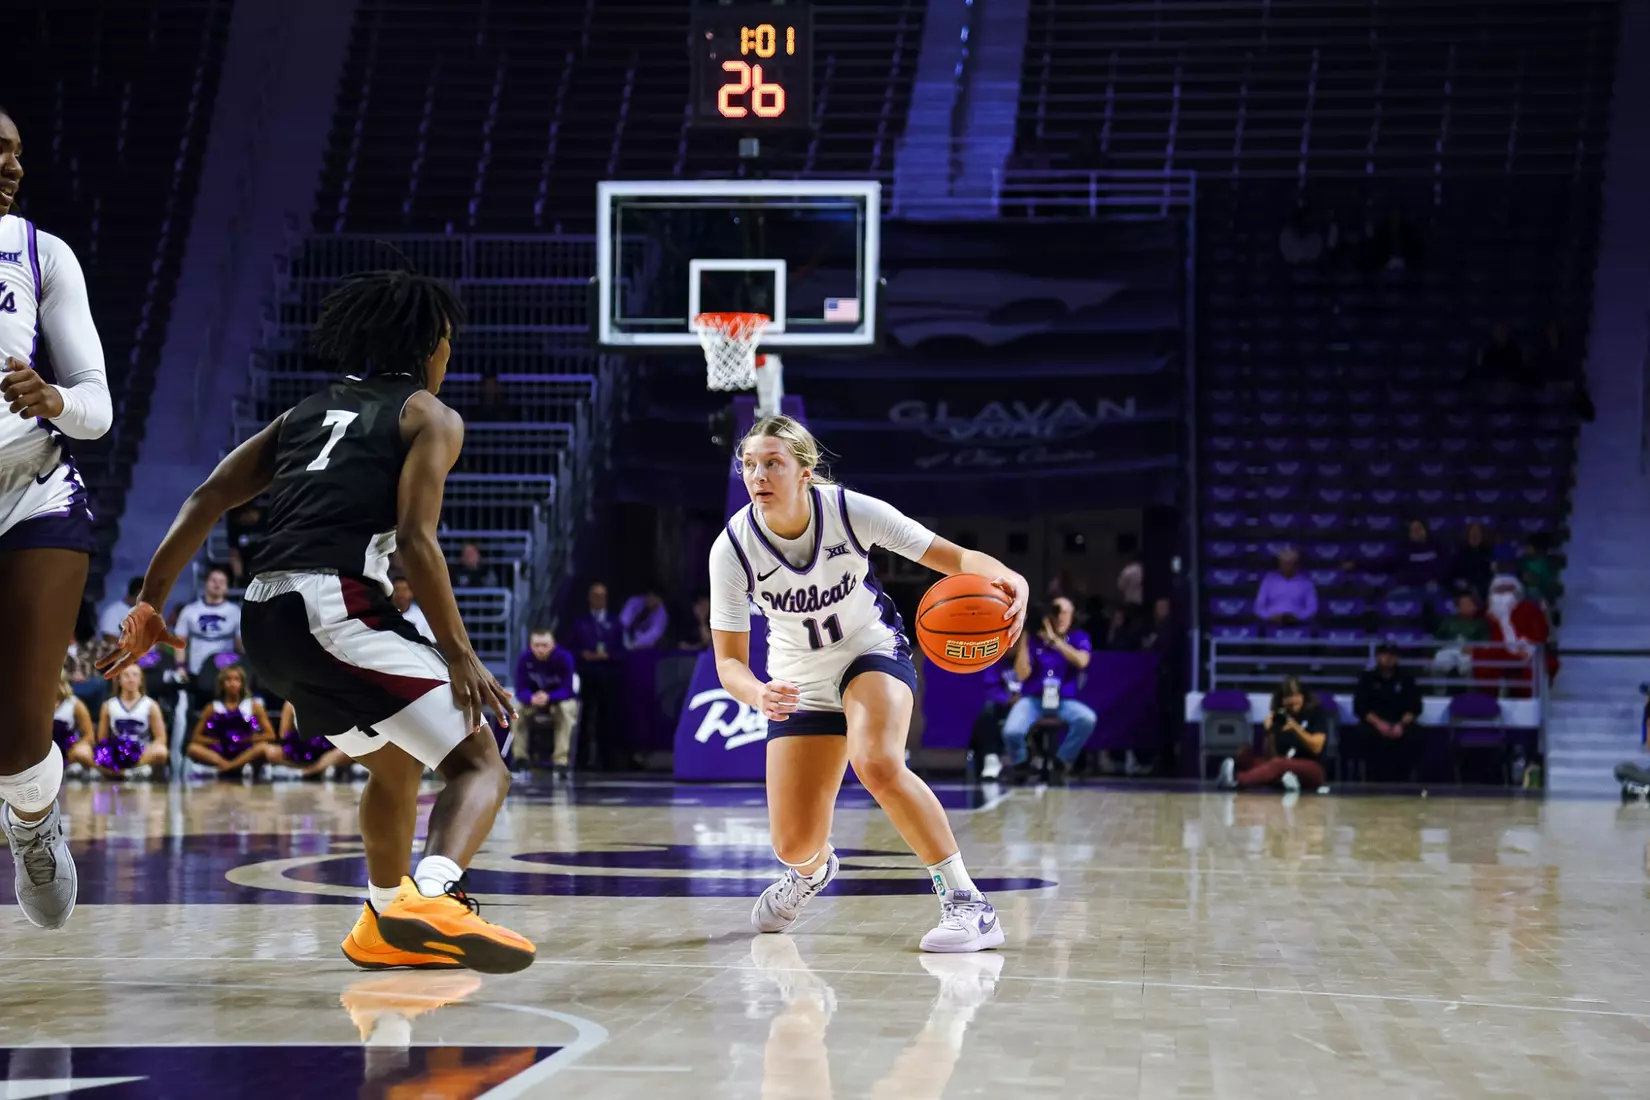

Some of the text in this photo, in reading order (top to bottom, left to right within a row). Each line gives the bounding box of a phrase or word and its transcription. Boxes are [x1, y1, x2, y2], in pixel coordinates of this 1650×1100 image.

[741, 24, 795, 58] 1:01
[718, 61, 785, 117] 26
[888, 396, 1137, 425] GLAVAN
[306, 410, 359, 471] 7
[824, 542, 851, 560] XII
[761, 571, 857, 613] Wildcats
[802, 613, 844, 650] 11
[945, 642, 999, 659] ELITE
